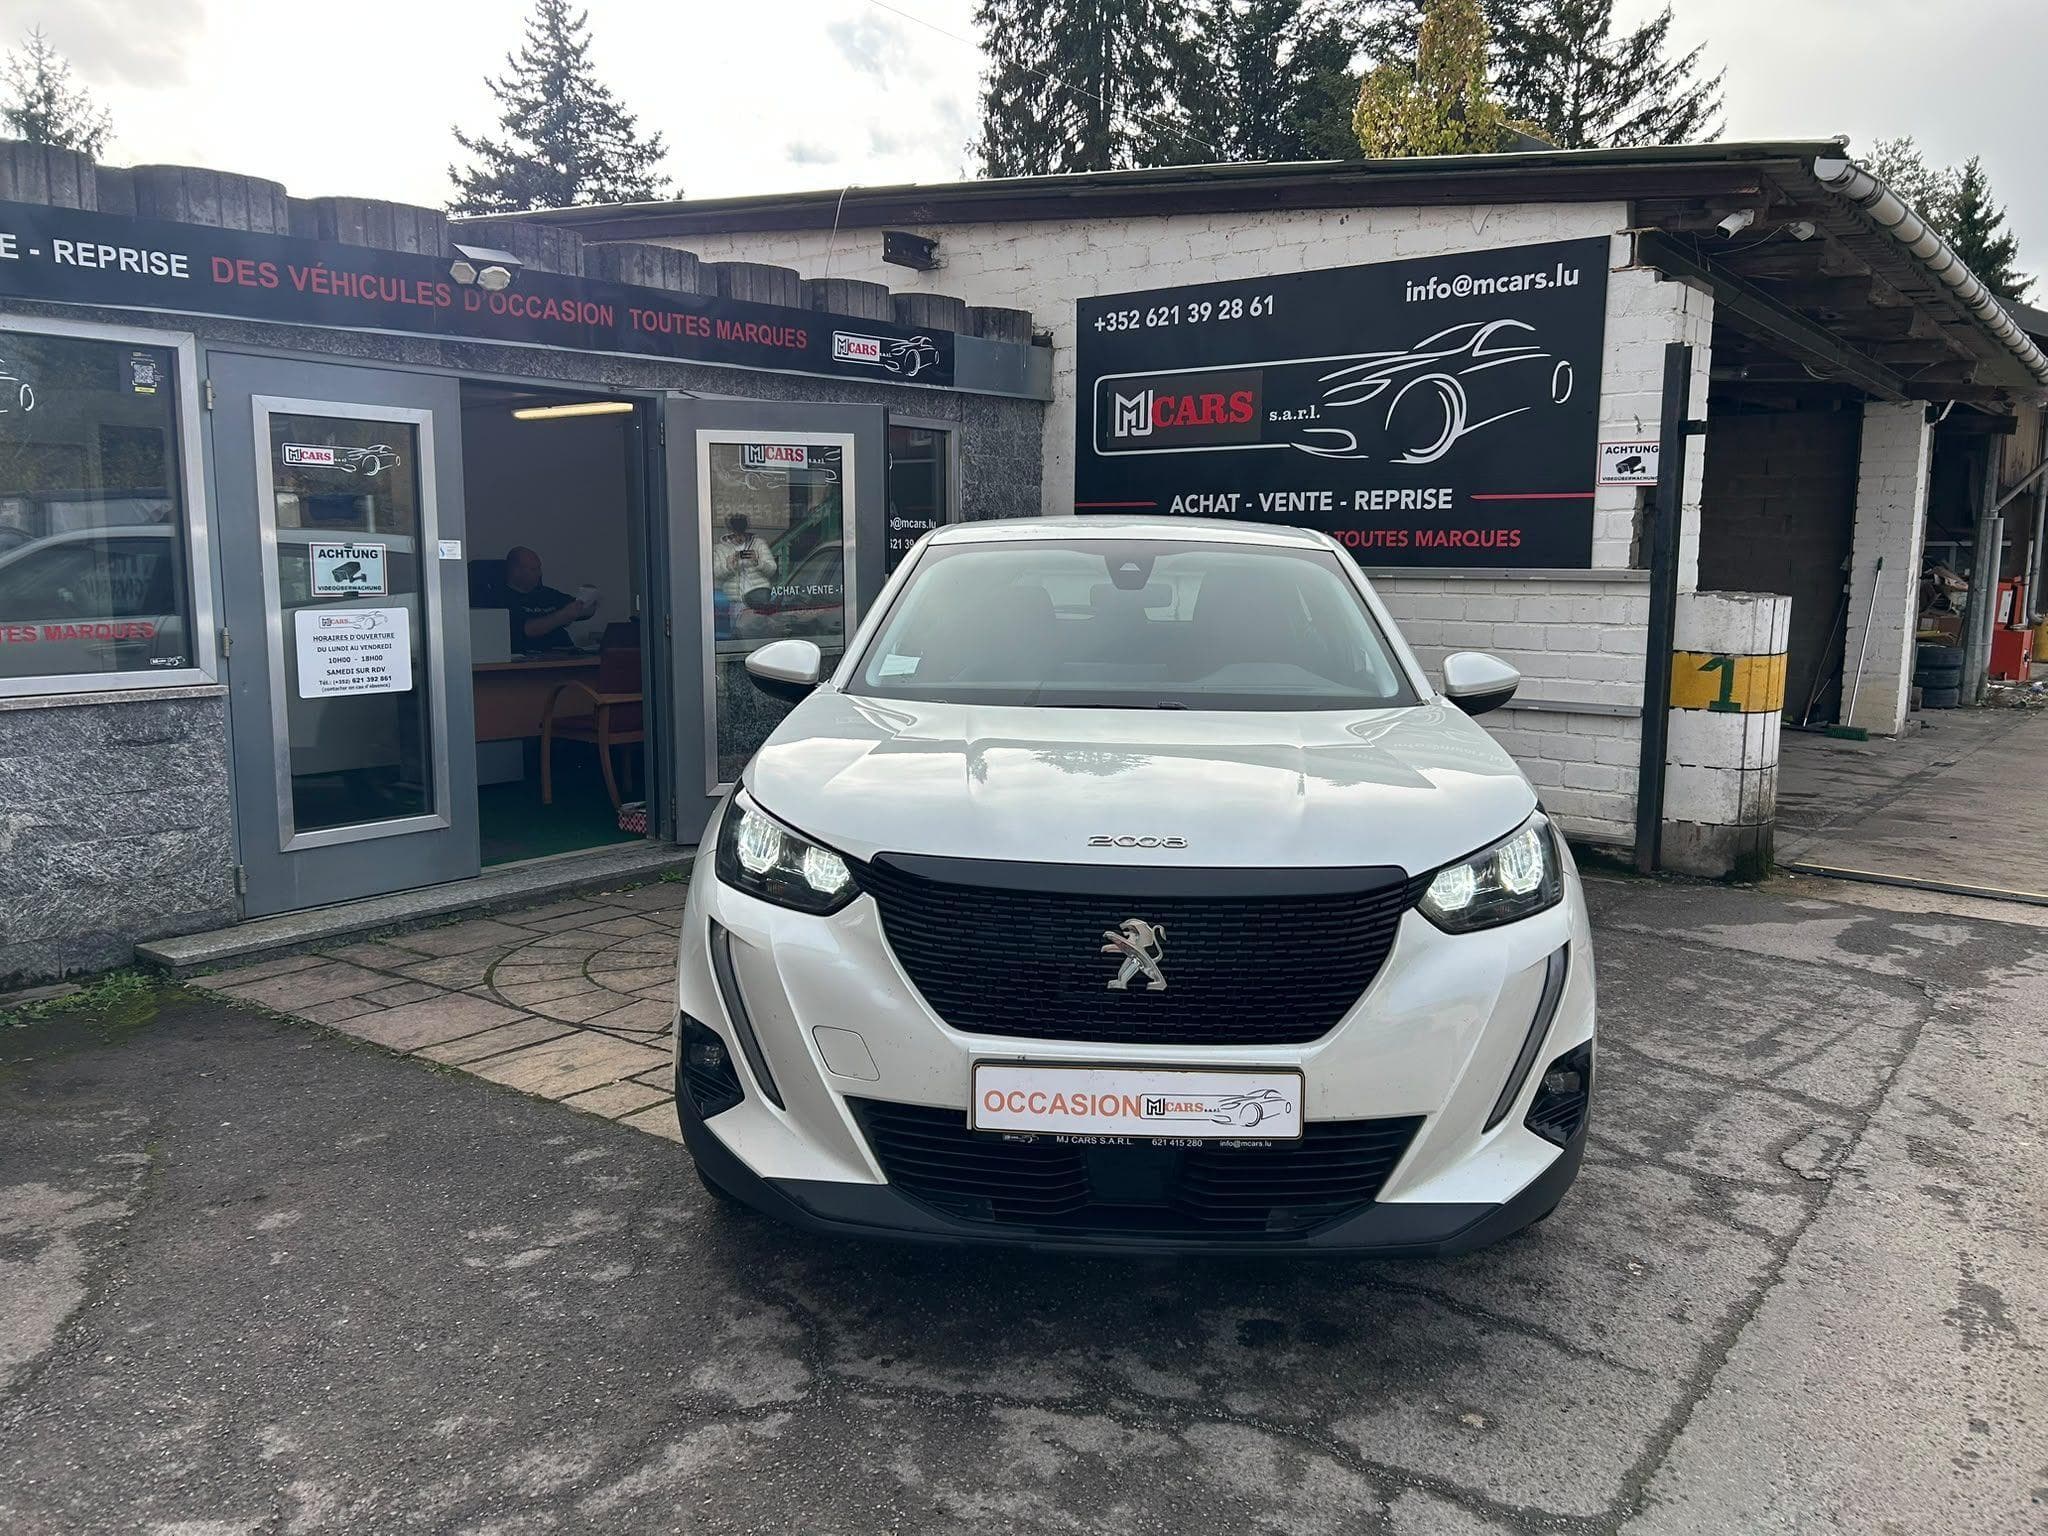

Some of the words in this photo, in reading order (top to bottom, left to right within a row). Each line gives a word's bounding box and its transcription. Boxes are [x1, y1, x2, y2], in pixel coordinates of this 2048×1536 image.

[53, 239, 189, 278] REPRISE
[1406, 263, 1579, 302] info@mcars.lu
[211, 256, 279, 289] DES
[288, 262, 451, 308] VÉHICULES
[464, 288, 613, 328] D'OCCASION
[629, 307, 710, 338] TOUTES
[717, 319, 806, 349] MARQUES
[1094, 310, 1140, 332] +352
[1146, 306, 1179, 328] 621
[1187, 301, 1212, 324] 39
[1218, 299, 1243, 321] 28
[1250, 295, 1274, 317] 61
[848, 342, 877, 356] CARS
[1152, 390, 1255, 428] CARS
[1269, 405, 1320, 422] s.a.r.l.
[301, 451, 331, 461] CARS
[765, 446, 804, 462] CARS
[1605, 445, 1659, 454] ACHTUNG
[1169, 493, 1240, 514] ACHAT
[1259, 491, 1333, 512] VENTE
[1354, 488, 1453, 511] REPRISE
[1334, 530, 1409, 548] TOUTES
[1415, 529, 1521, 548] MARQUES
[318, 549, 379, 559] ACHTUNG
[771, 586, 800, 596] ACHAT
[806, 584, 834, 595] VENTE
[44, 622, 156, 641] MARQUES
[313, 634, 349, 642] HORAIRES
[360, 643, 392, 651] VENDREDI
[326, 668, 354, 676] SAMEDI
[1698, 656, 1742, 713] 1
[1087, 835, 1189, 849] 2008
[984, 1090, 1141, 1117] OCCASION
[1165, 1102, 1204, 1112] CARS
[1056, 1135, 1069, 1144] MJ
[1071, 1135, 1098, 1144] CARS
[1152, 1138, 1168, 1146] 621
[1169, 1139, 1185, 1147] 415
[1186, 1139, 1203, 1147] 280
[1220, 1140, 1271, 1149] info@mcars.lu
